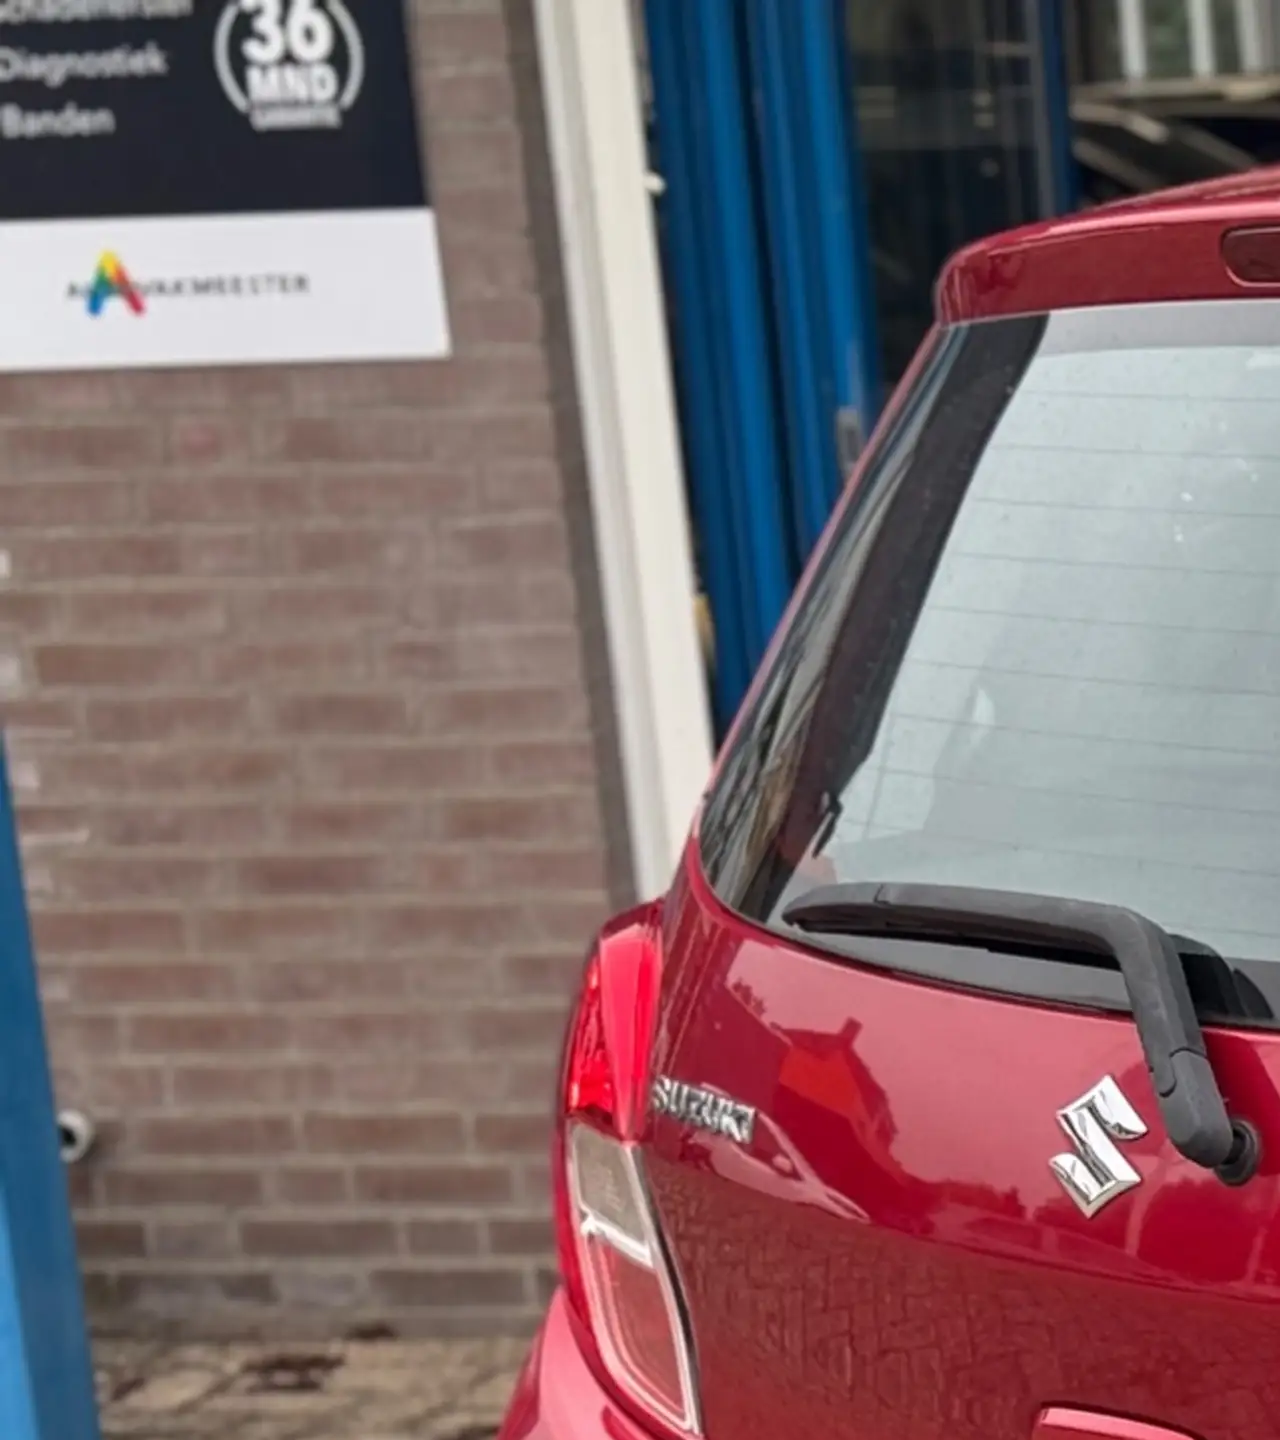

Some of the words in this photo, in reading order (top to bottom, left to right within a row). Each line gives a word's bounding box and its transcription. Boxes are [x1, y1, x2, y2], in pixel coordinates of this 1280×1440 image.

[241, 0, 334, 63] 36
[246, 65, 338, 103] MND
[2, 101, 116, 138] Banden
[652, 1074, 756, 1145] SUZUKI
